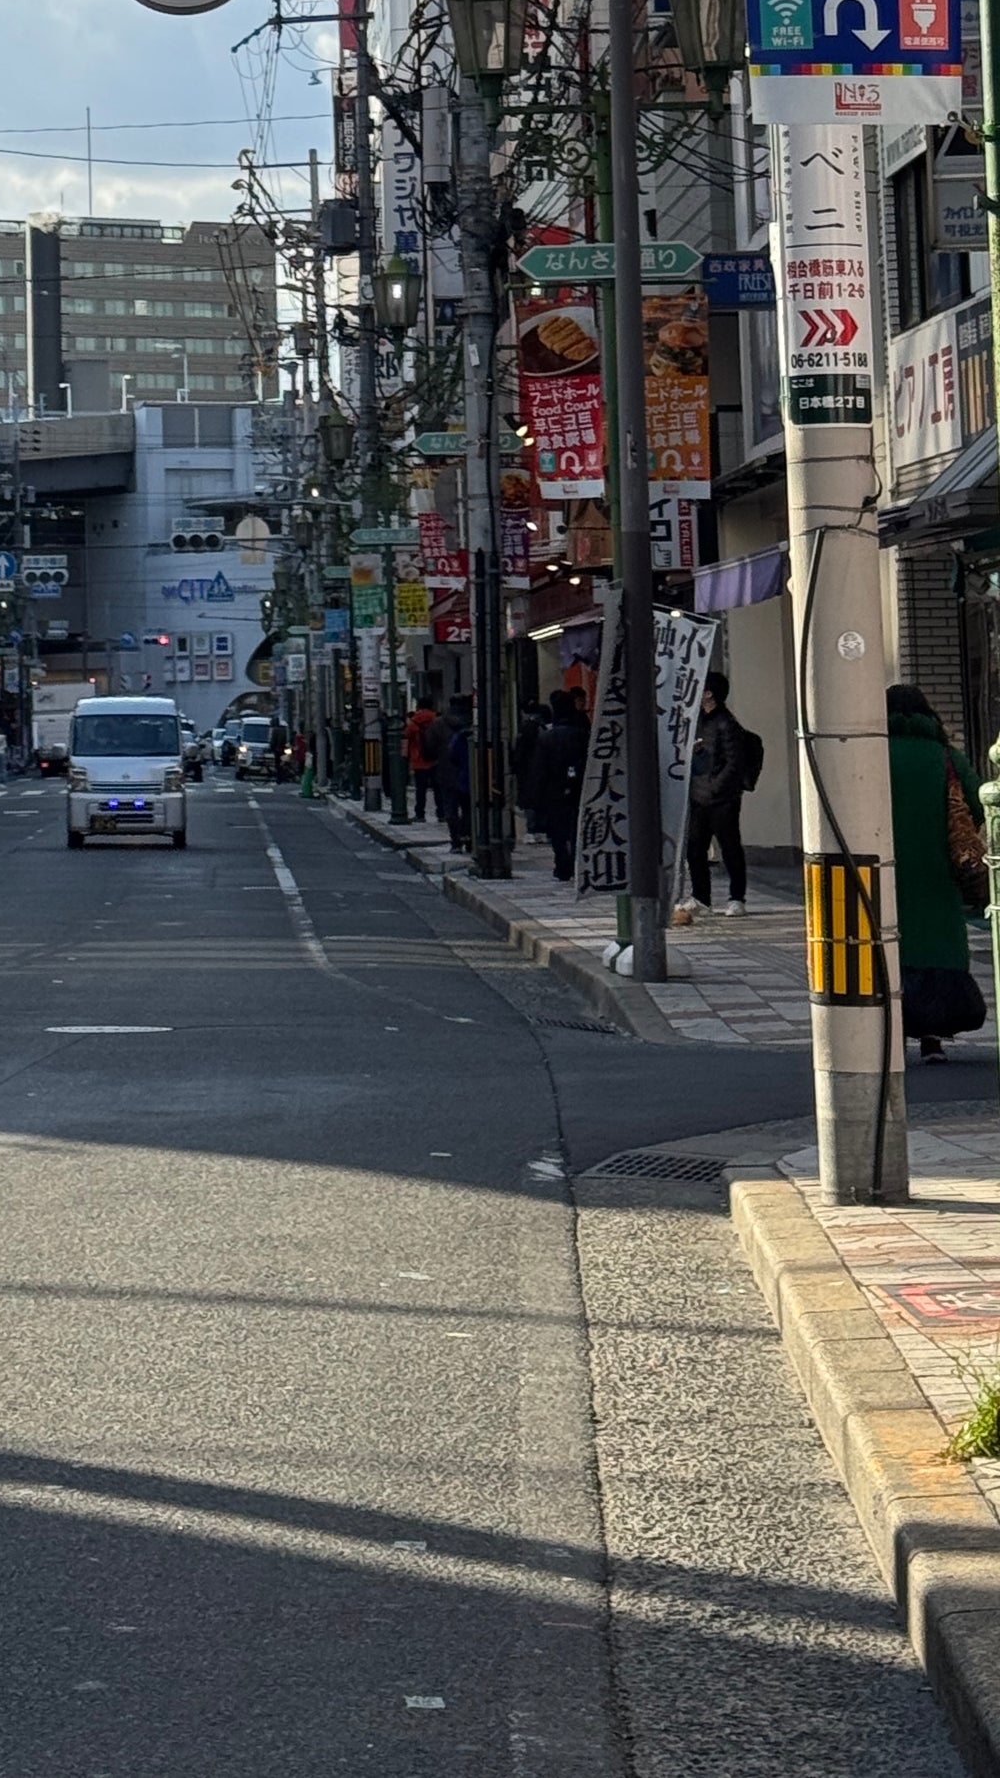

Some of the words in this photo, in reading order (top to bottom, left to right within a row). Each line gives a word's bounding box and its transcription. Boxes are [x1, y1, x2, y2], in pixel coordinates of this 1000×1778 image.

[773, 26, 801, 36] FREE
[771, 37, 804, 46] Wi-Fi
[800, 147, 845, 230] ベニ
[545, 249, 677, 271] なんさ通り
[791, 352, 868, 369] 06-6211-5188
[529, 383, 600, 405] フードホール
[648, 384, 708, 402] ードホール
[532, 405, 562, 417] Food
[564, 399, 600, 413] Court
[799, 395, 865, 410] 日本橋2丁目
[447, 626, 471, 642] 2F
[667, 627, 707, 780] 小動物と
